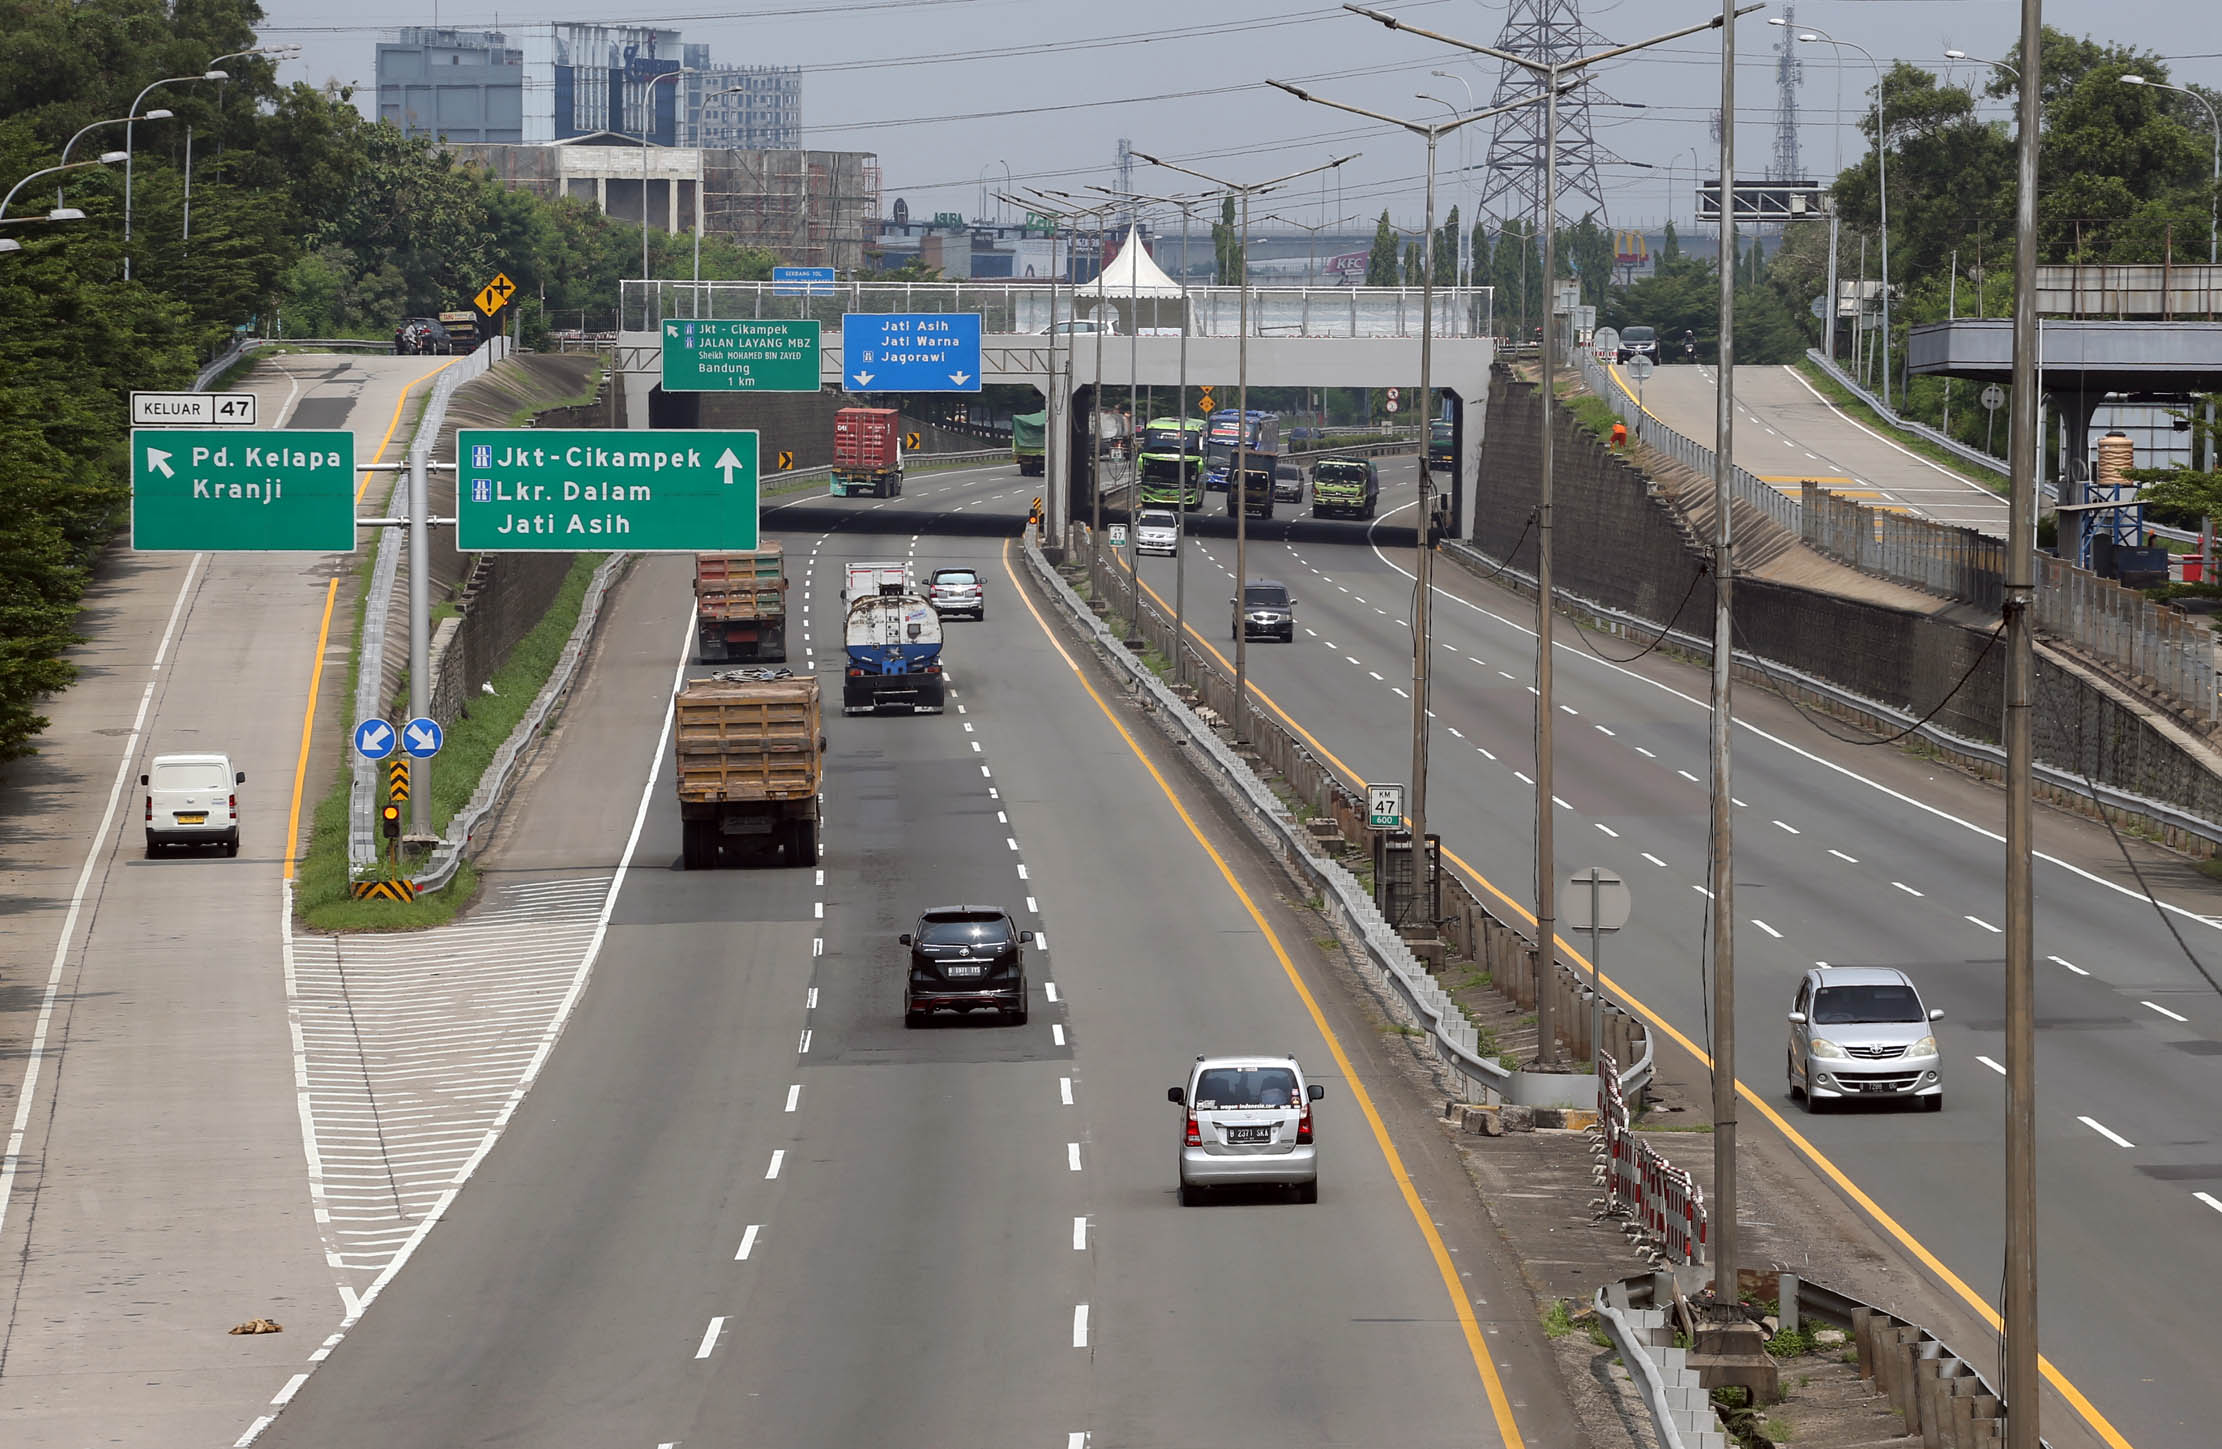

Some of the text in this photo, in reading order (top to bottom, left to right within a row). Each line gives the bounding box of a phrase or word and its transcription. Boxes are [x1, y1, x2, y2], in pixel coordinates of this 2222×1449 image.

[1336, 257, 1362, 269] KFC
[699, 325, 716, 334] Jkt
[731, 325, 788, 337] Cikampek
[881, 321, 949, 332] Jati Asih
[699, 339, 811, 348] JALAN LAYANG MBZ
[881, 336, 960, 347] Jati Warna
[698, 352, 801, 360] Sheikh MOHAMED BIN ZAYED
[881, 352, 945, 364] Jagorawi
[699, 363, 750, 375] Bandung
[728, 377, 755, 386] 1 km
[144, 401, 249, 417] KELUAR 47
[192, 447, 341, 471] Pd. Kelapa
[193, 478, 282, 505] Kranji
[497, 481, 651, 501] Lkr. Dalam
[497, 513, 630, 534] Jati Asih
[1375, 800, 1395, 814] 47
[1376, 816, 1393, 824] 600
